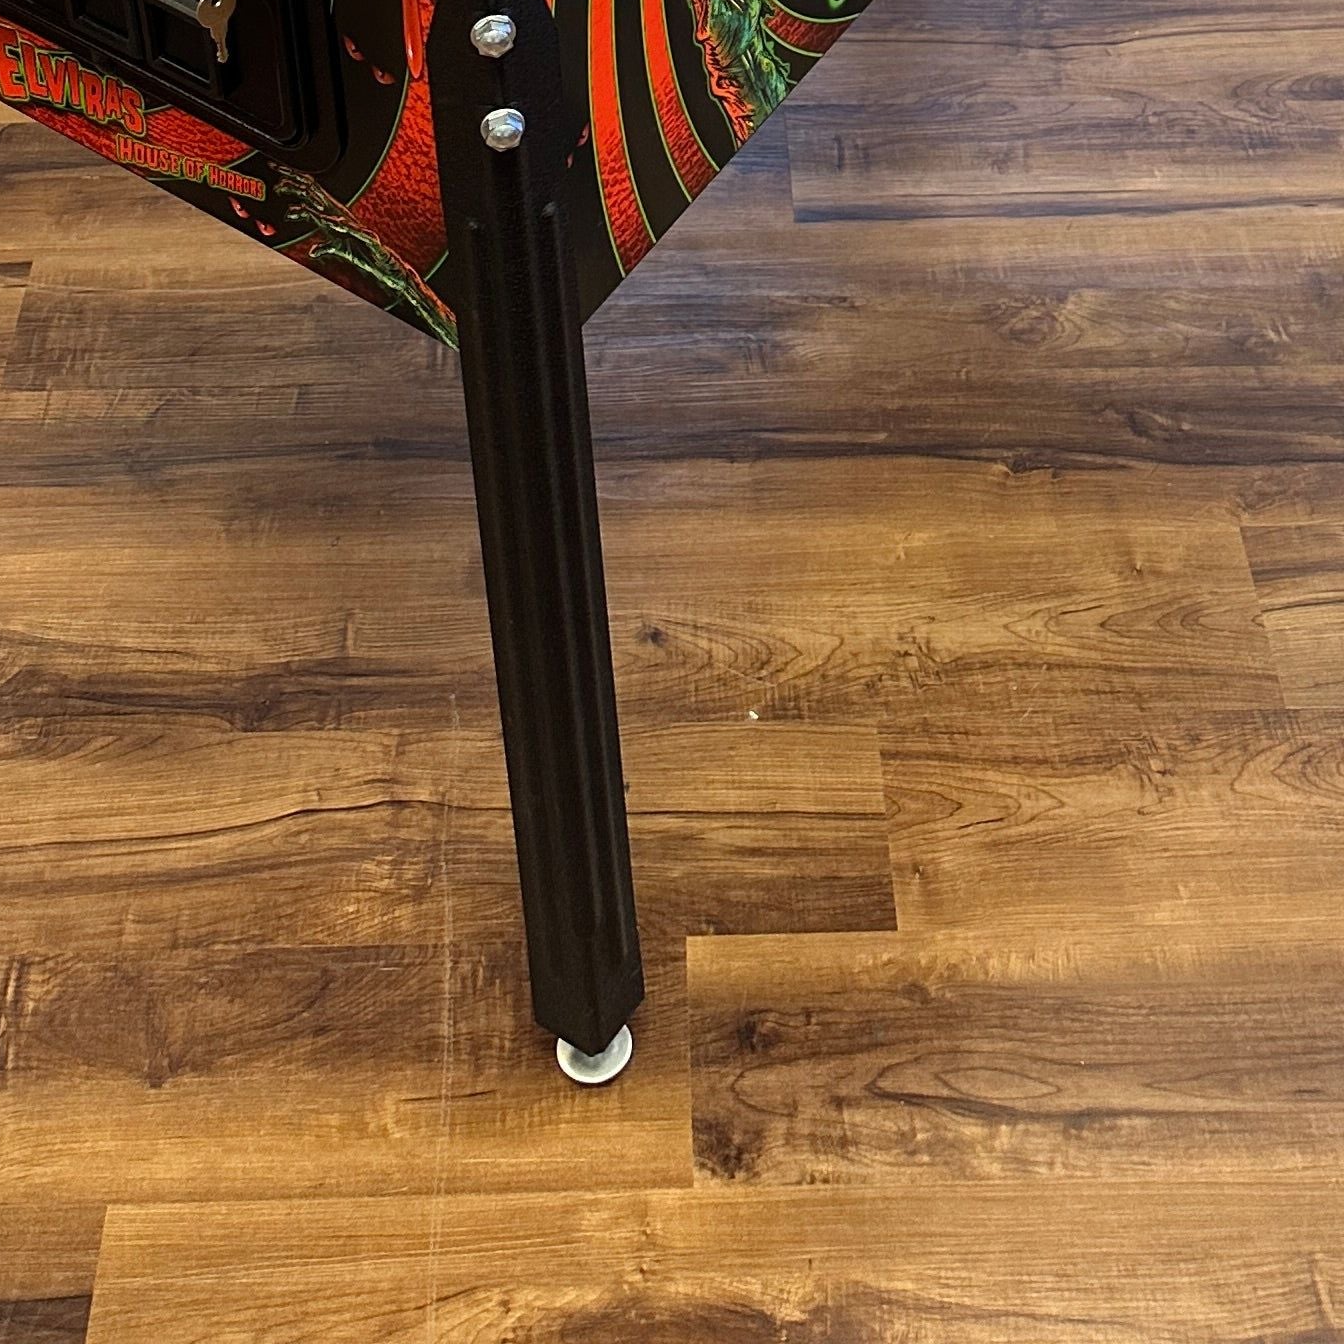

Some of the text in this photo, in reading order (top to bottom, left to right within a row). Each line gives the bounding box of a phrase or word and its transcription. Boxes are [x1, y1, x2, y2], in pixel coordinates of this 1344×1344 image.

[115, 134, 266, 202] HOUSE OF HORRORS
